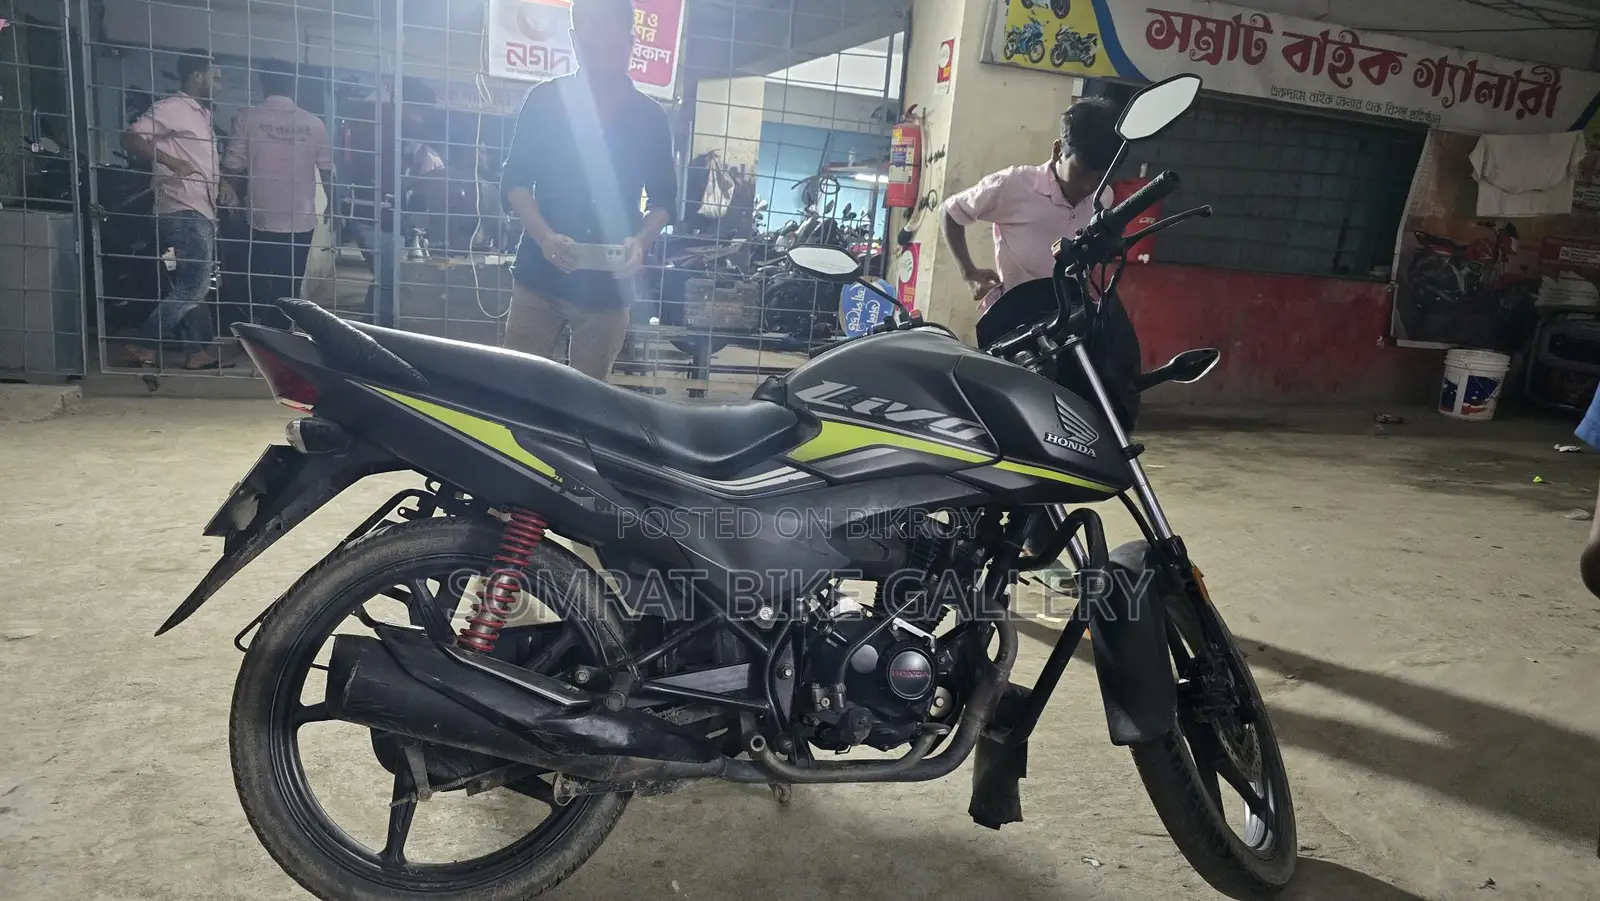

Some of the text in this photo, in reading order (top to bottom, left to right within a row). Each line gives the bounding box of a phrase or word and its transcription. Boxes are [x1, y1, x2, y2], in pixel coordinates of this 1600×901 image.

[1145, 8, 1563, 120] সম্রাট বাইক গ্যালারী
[1045, 433, 1097, 458] HONDA
[891, 669, 930, 678] HONDA
